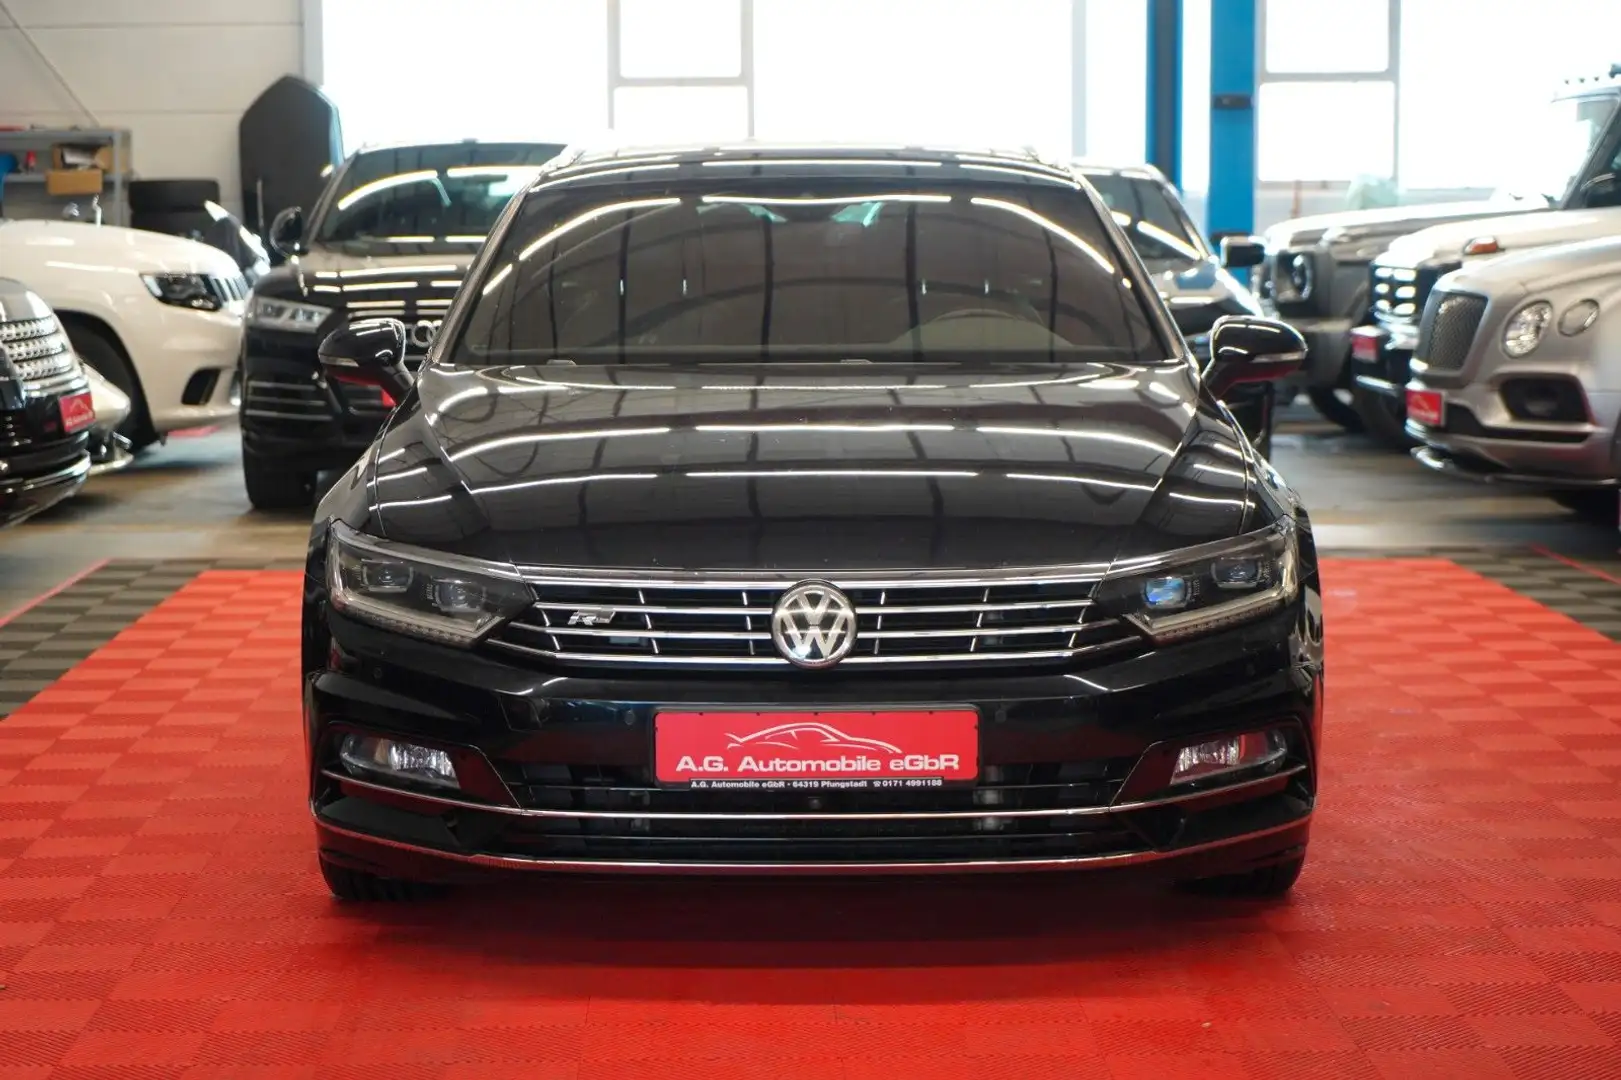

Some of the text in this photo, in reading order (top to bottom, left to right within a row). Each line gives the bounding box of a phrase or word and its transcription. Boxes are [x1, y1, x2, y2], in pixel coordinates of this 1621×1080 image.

[676, 754, 960, 772] A.G. Automobile eGbR
[690, 780, 709, 788] A.G.
[711, 780, 760, 788] Automobile
[761, 780, 786, 788] eGbR
[792, 780, 820, 789] 64319
[820, 780, 868, 789] Pfungstadt
[882, 779, 903, 787] 0171
